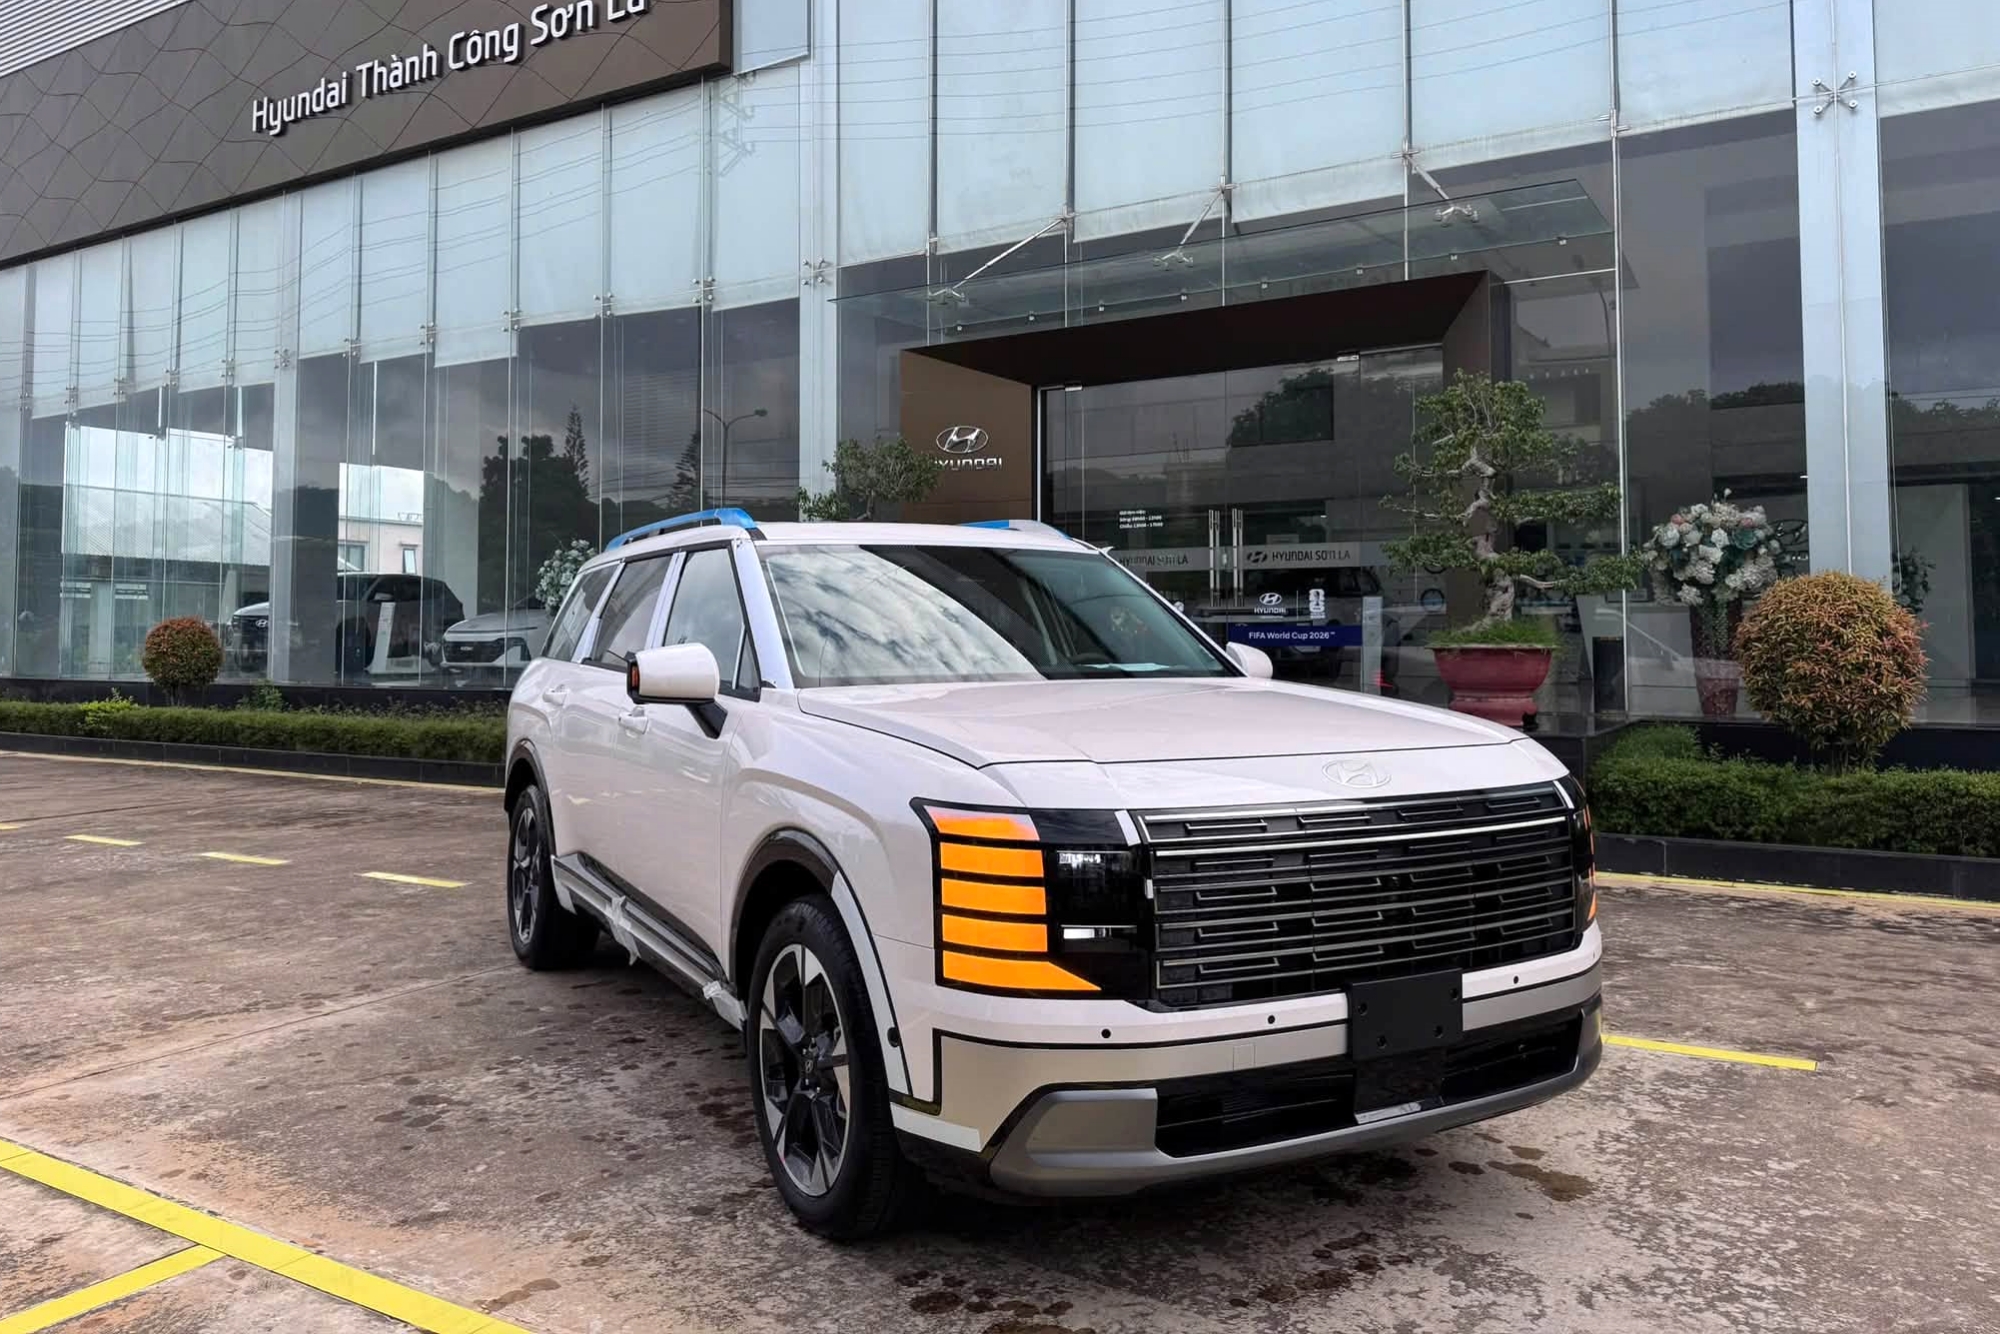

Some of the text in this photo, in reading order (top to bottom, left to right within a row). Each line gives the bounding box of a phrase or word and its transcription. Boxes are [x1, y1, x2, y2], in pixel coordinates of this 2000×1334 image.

[251, 72, 348, 136] Hyundai
[356, 44, 439, 97] Thành
[447, 24, 521, 71] Công
[531, 0, 594, 45] Sơn
[934, 457, 1002, 471] YUNDAI
[1272, 551, 1313, 562] HYUNDAI
[1267, 631, 1291, 639] World
[1292, 631, 1309, 641] Cup
